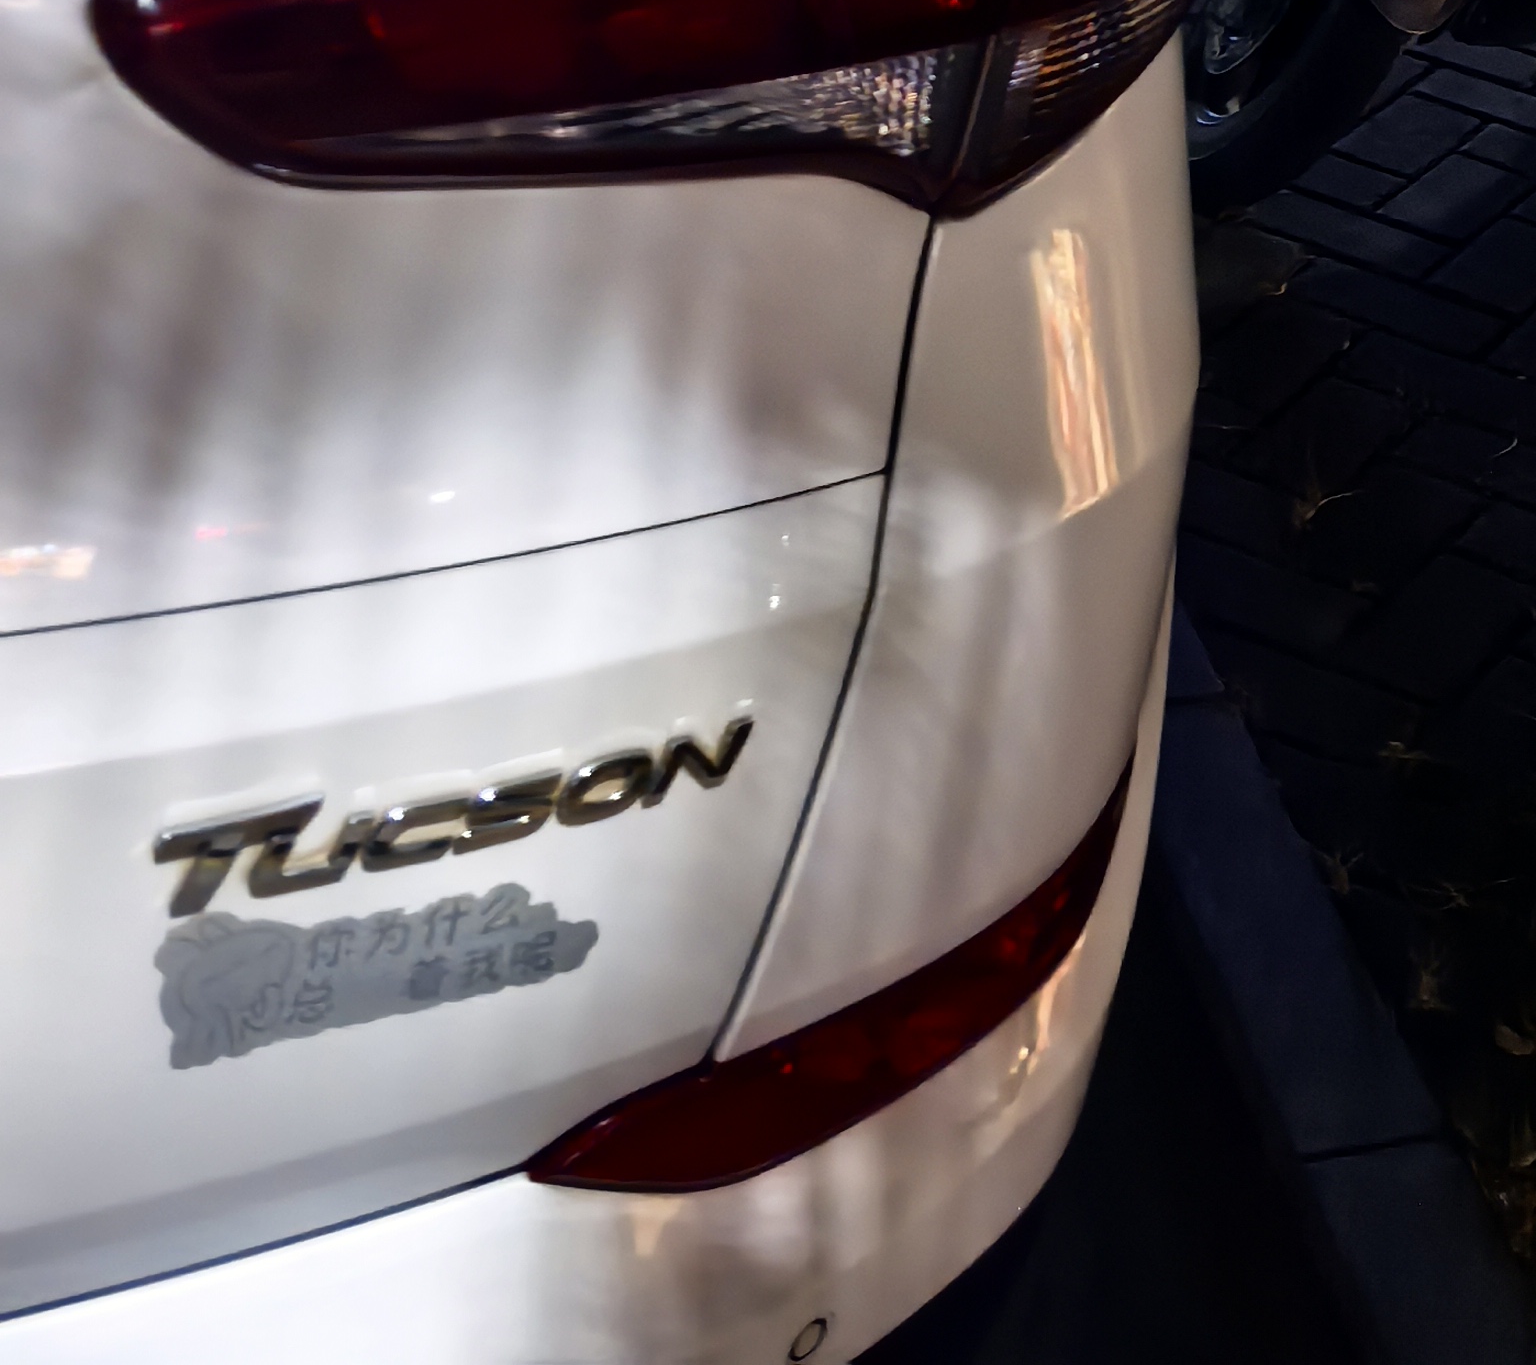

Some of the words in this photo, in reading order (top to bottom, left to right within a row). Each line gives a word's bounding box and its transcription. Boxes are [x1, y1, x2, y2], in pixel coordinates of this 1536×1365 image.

[152, 713, 756, 919] TUCSON
[309, 890, 521, 970] 你为什么
